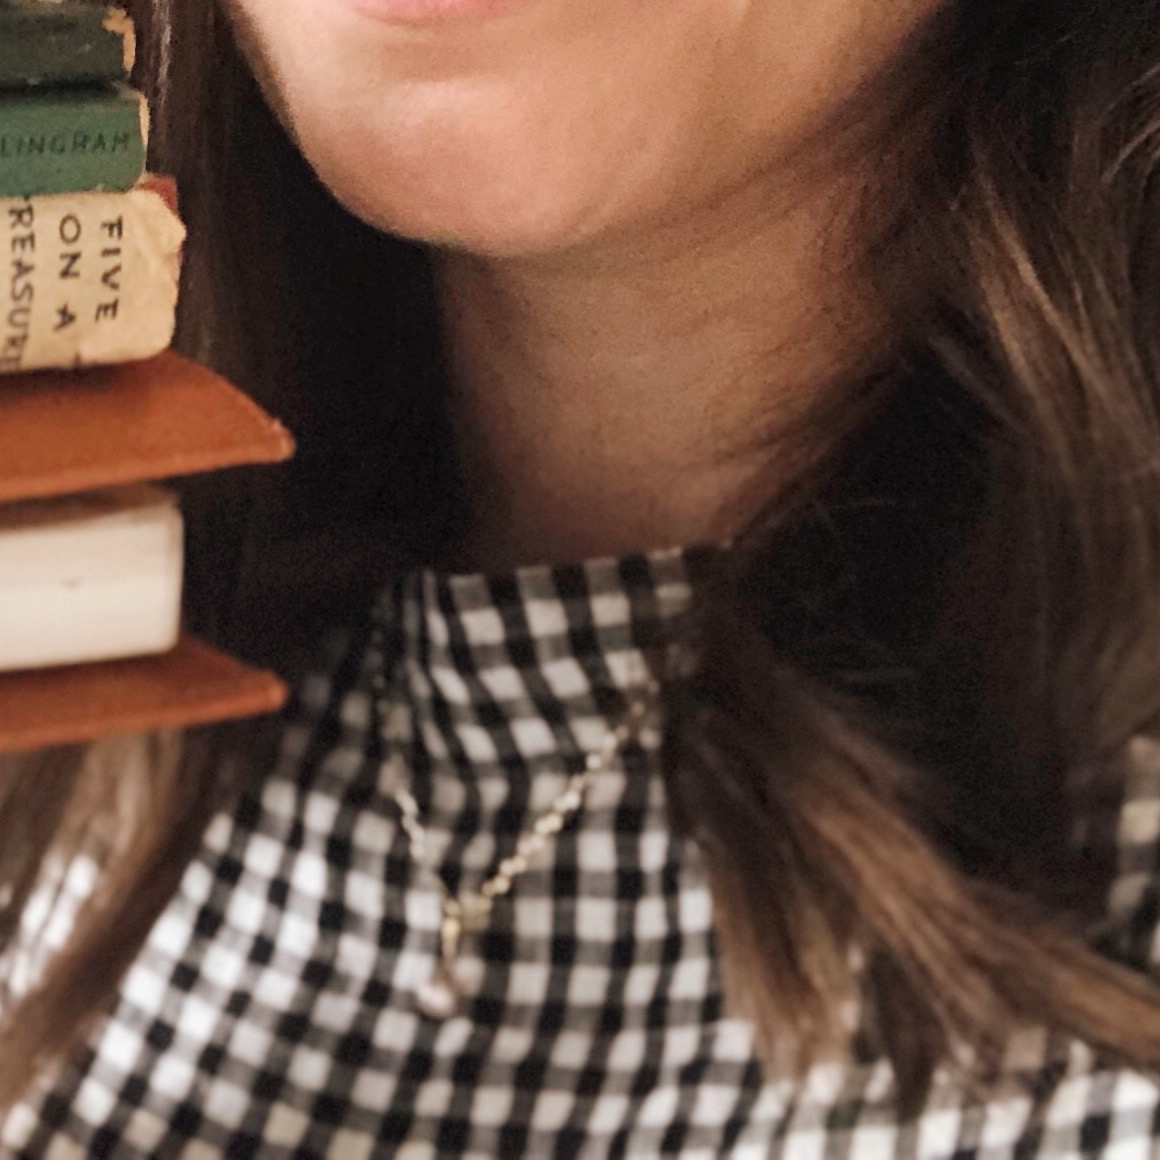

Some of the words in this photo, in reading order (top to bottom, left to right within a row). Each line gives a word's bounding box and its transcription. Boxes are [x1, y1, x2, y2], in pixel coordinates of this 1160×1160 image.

[58, 214, 82, 280] ON
[94, 215, 124, 323] FIVE
[54, 303, 77, 333] A
